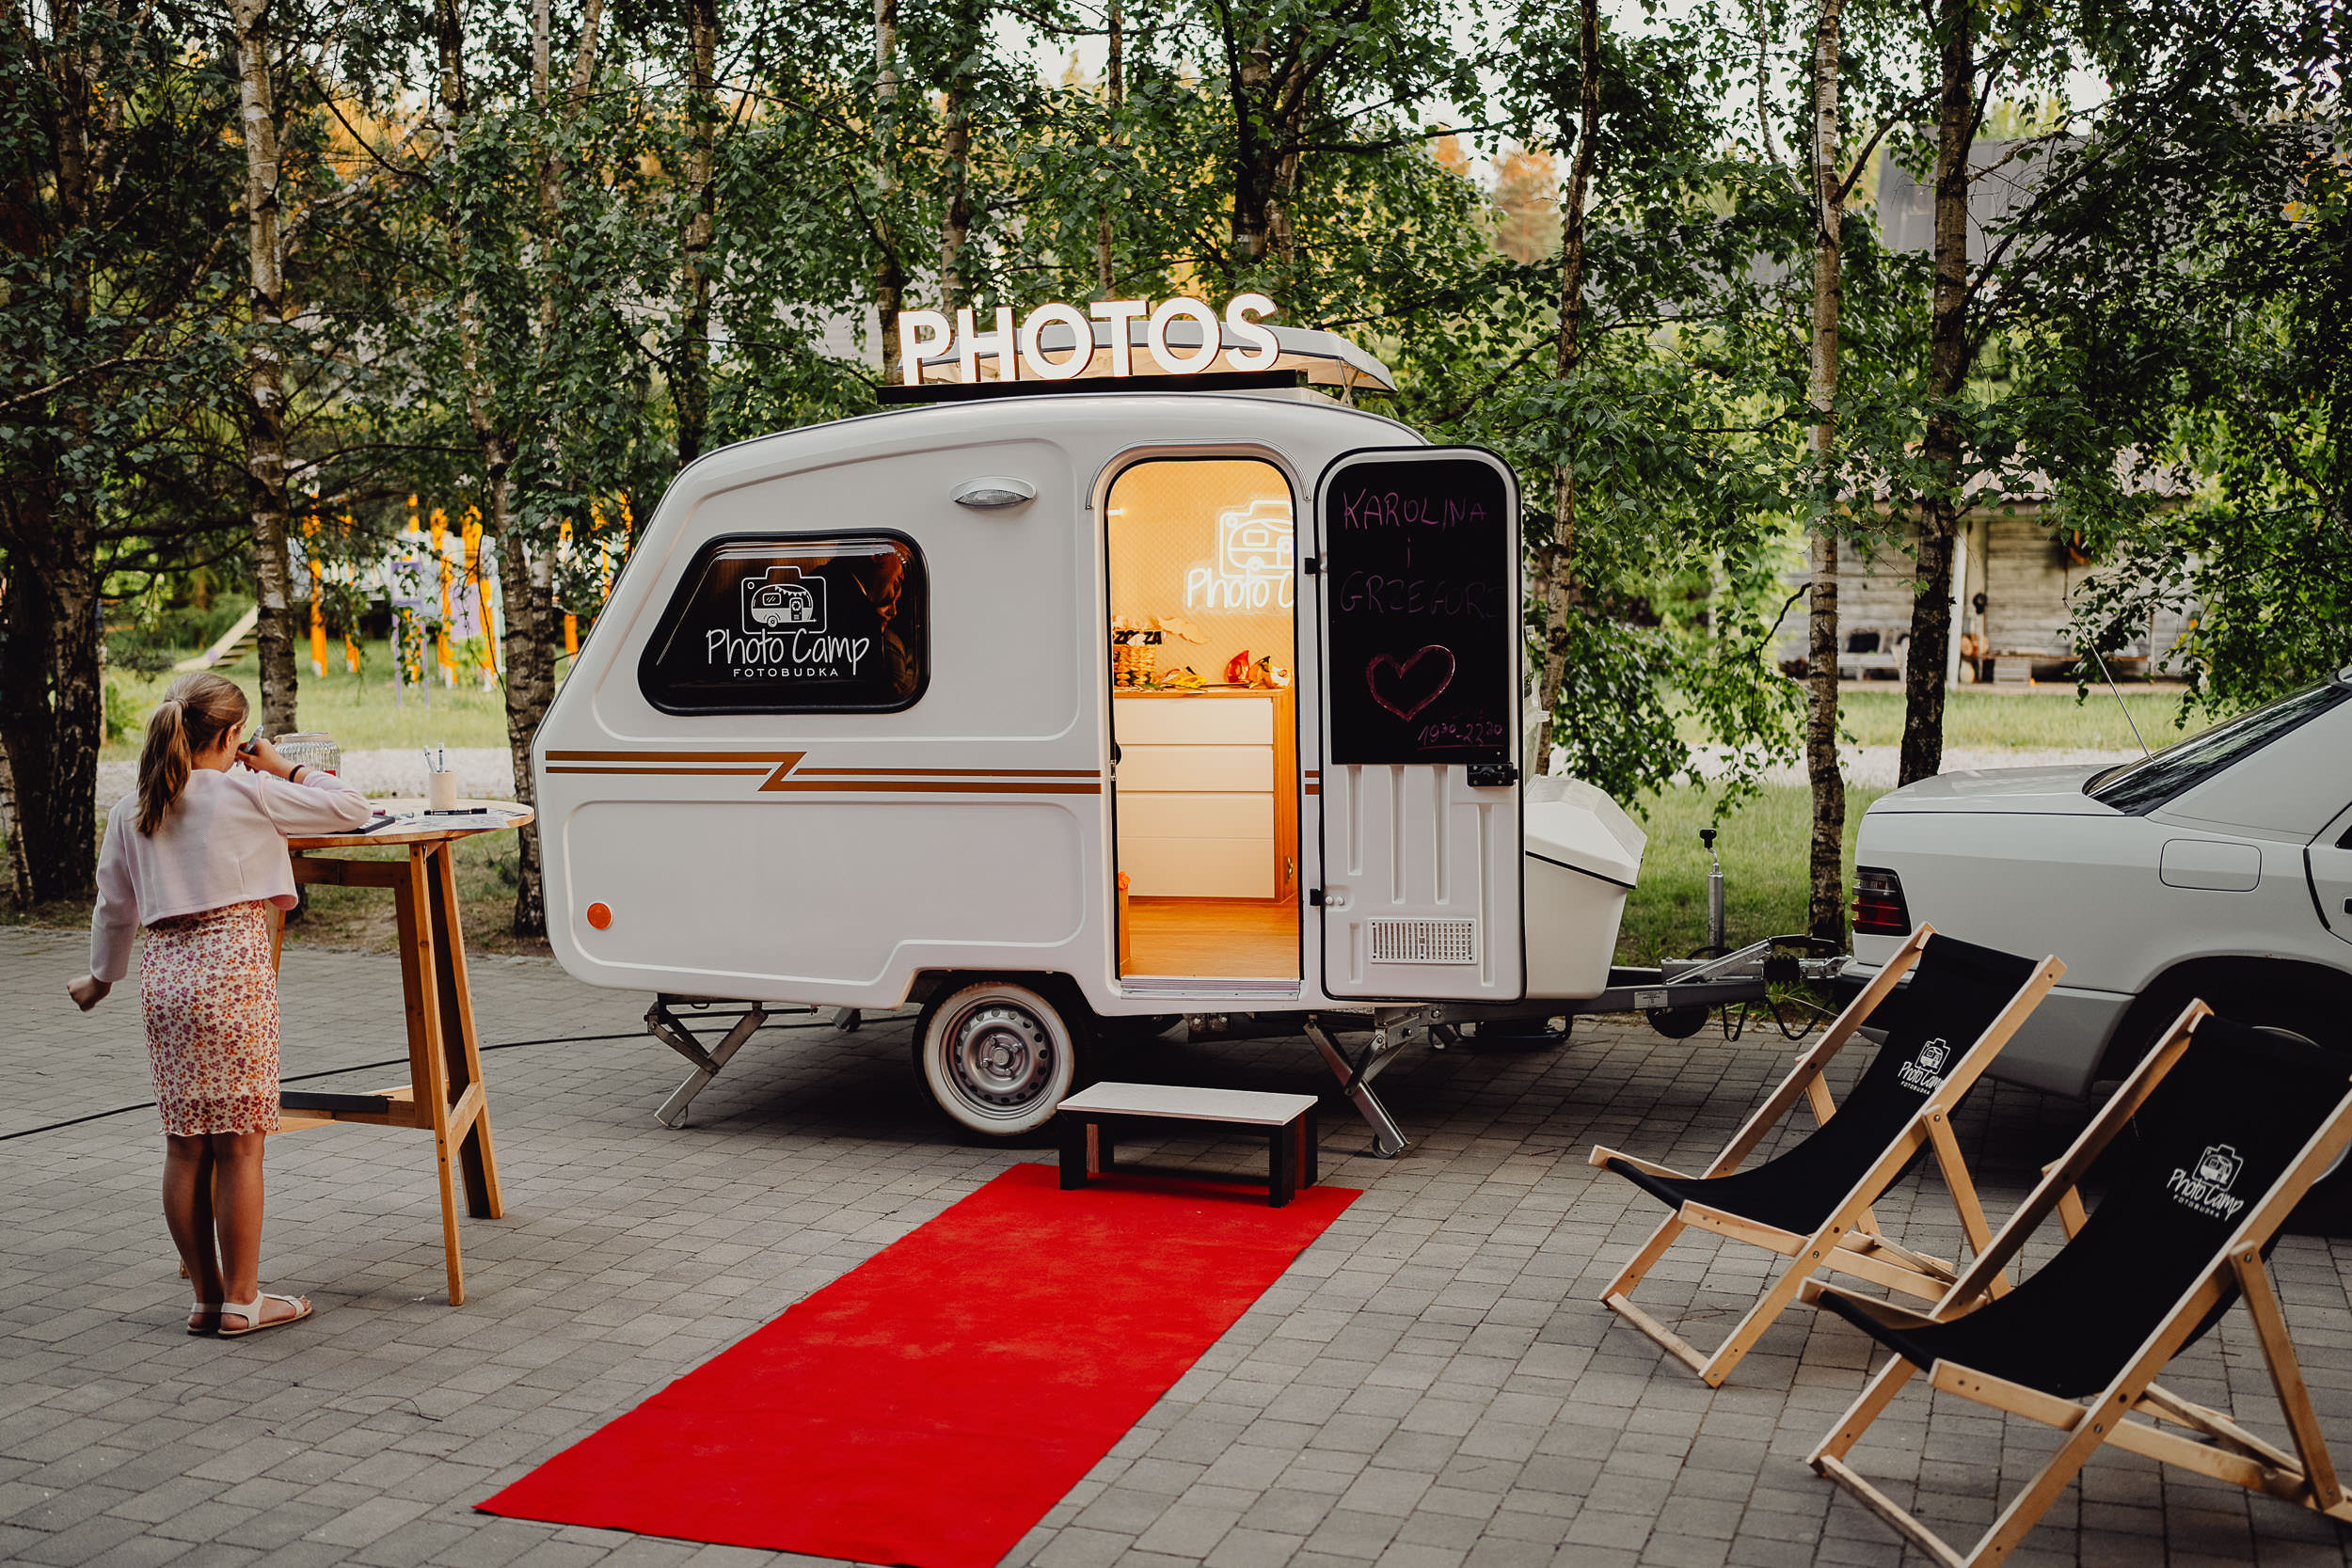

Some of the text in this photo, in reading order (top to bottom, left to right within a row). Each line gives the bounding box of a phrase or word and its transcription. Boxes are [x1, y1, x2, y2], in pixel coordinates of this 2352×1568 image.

[898, 293, 1280, 386] PHOTOS
[1342, 488, 1487, 531] KAROLINA
[1186, 567, 1270, 610] Photo
[706, 628, 869, 675] Photo Camp
[733, 668, 839, 677] FOTOBUDKA
[1898, 1061, 1923, 1084] Photo
[2167, 1167, 2245, 1222] Photo Camp
